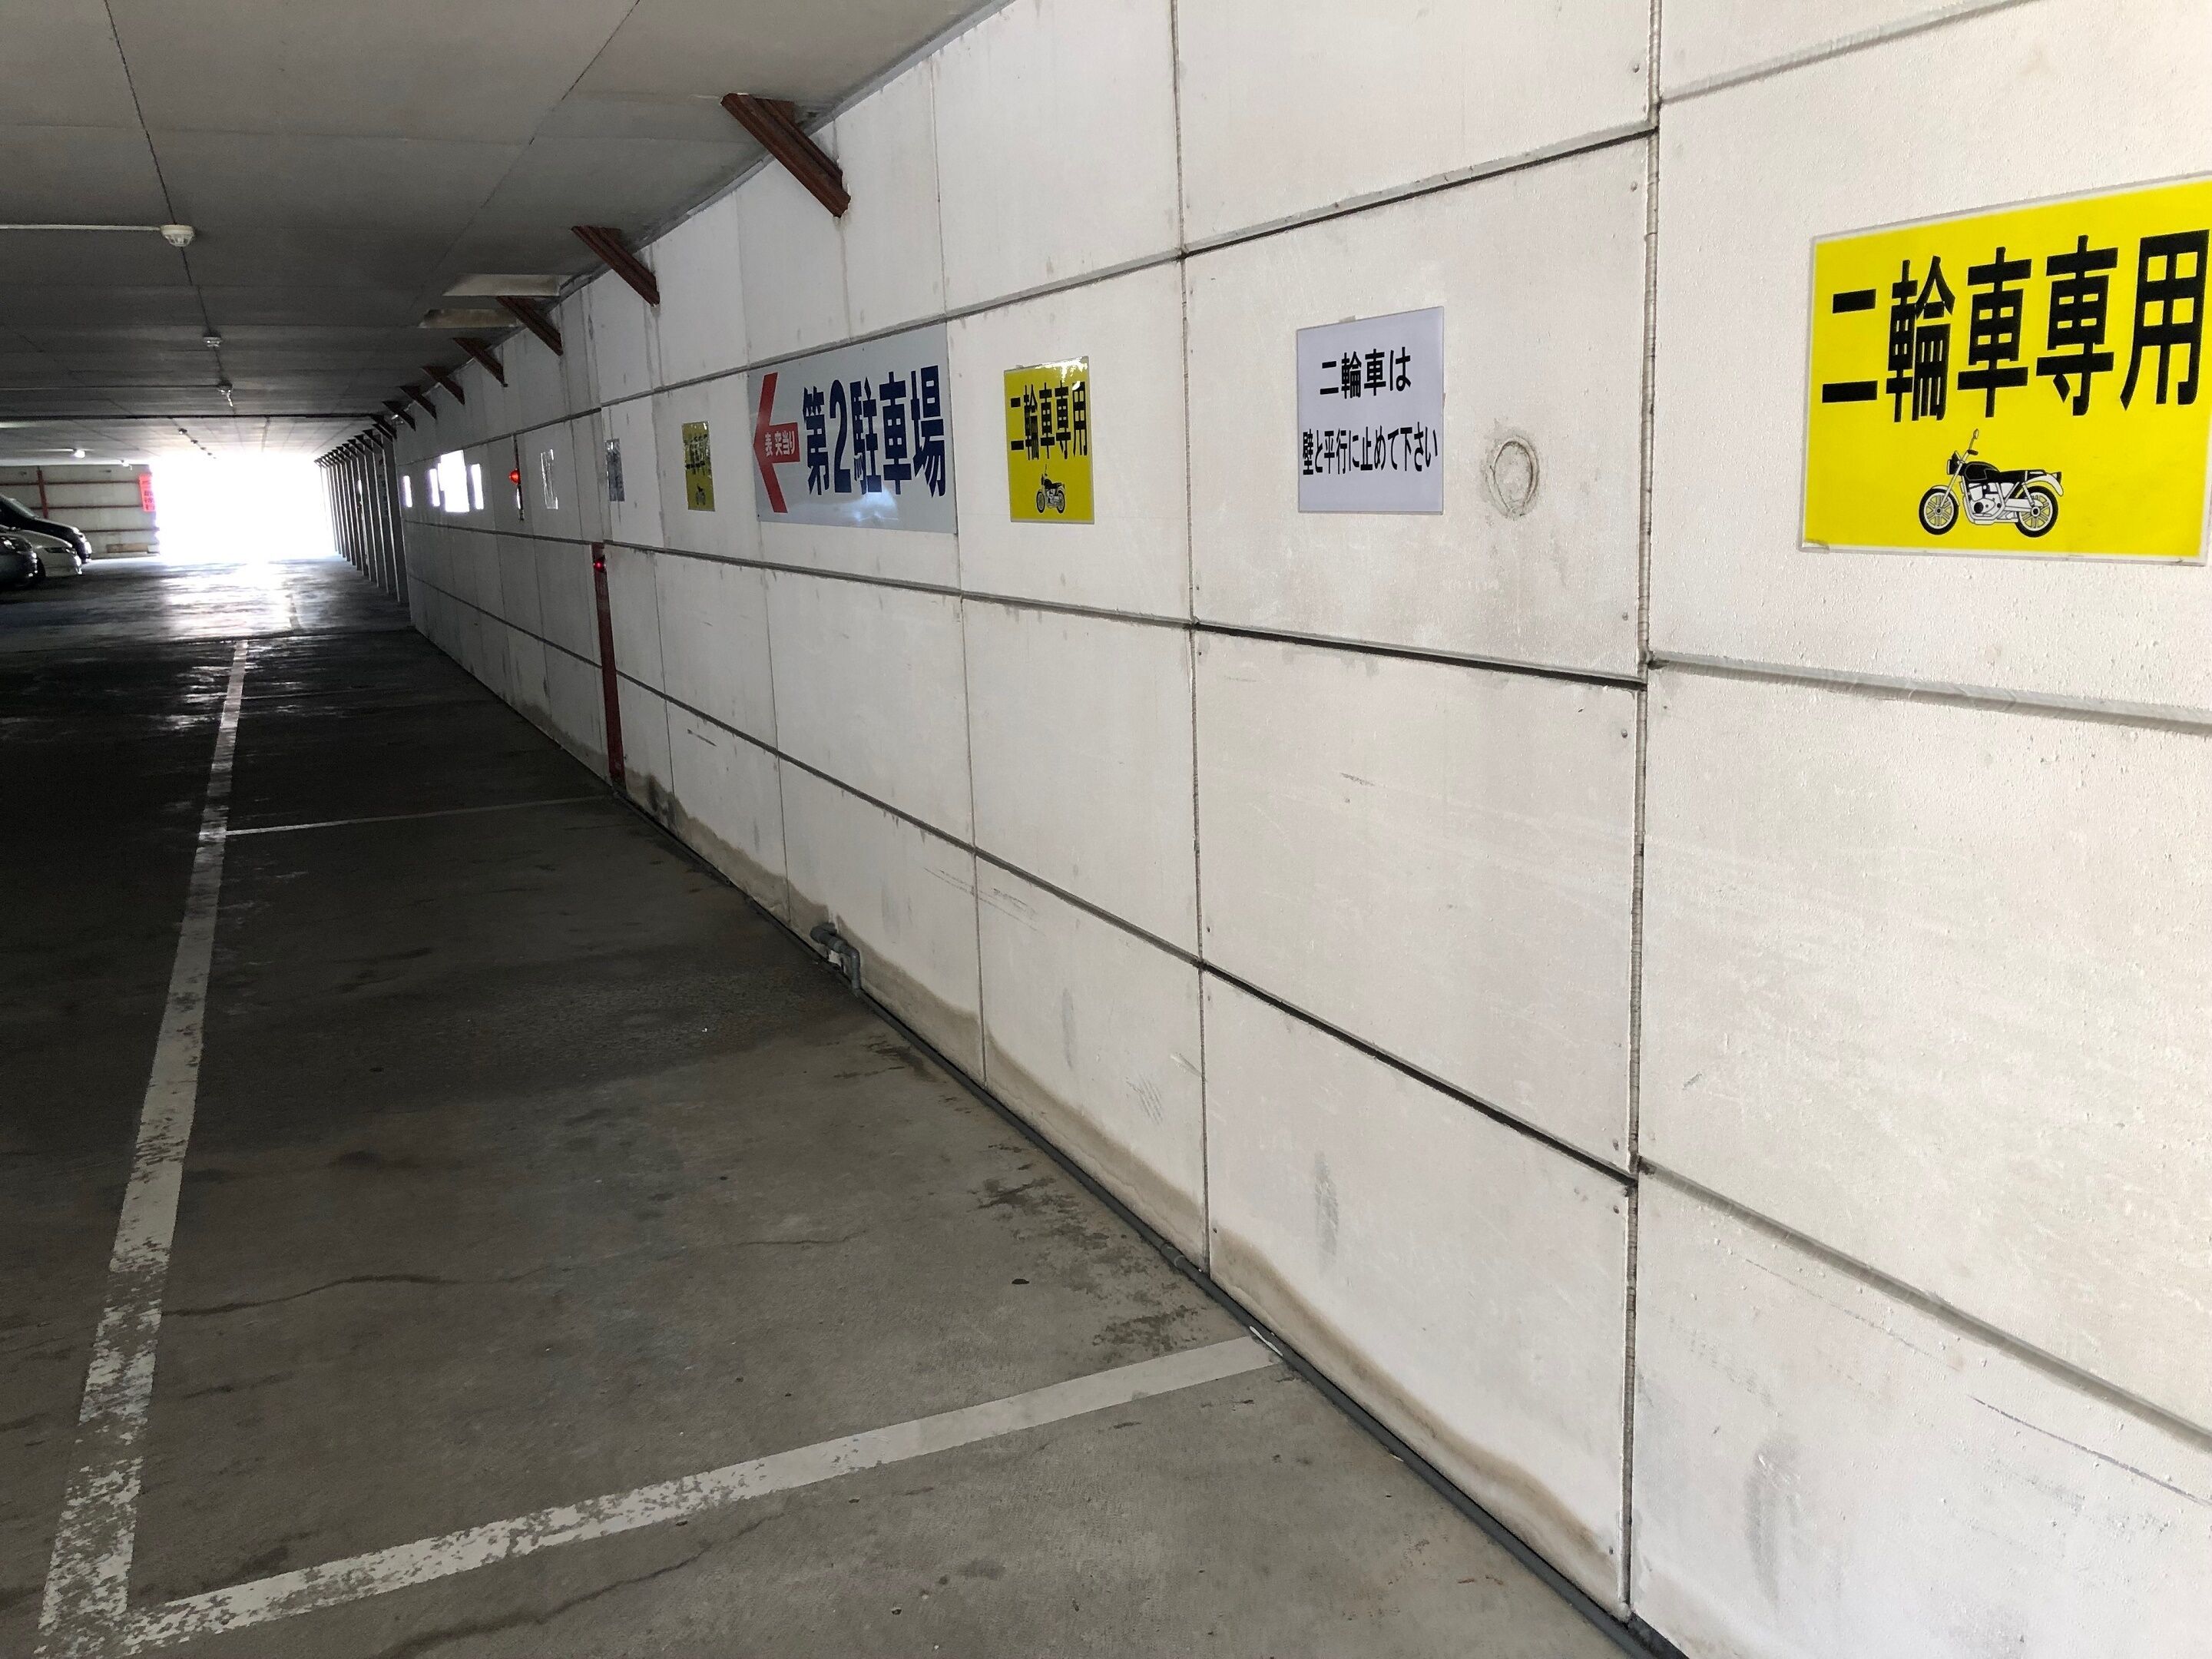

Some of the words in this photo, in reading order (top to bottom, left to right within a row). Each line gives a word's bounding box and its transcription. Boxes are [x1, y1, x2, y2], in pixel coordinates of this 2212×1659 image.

[1822, 229, 2210, 422] 二輪車専用
[1320, 346, 1412, 399] 二輪車は
[802, 365, 946, 498] 第2駐車場
[1010, 380, 1088, 461] 二輪車専用
[1302, 422, 1439, 475] 壁と平行に止めて下さい
